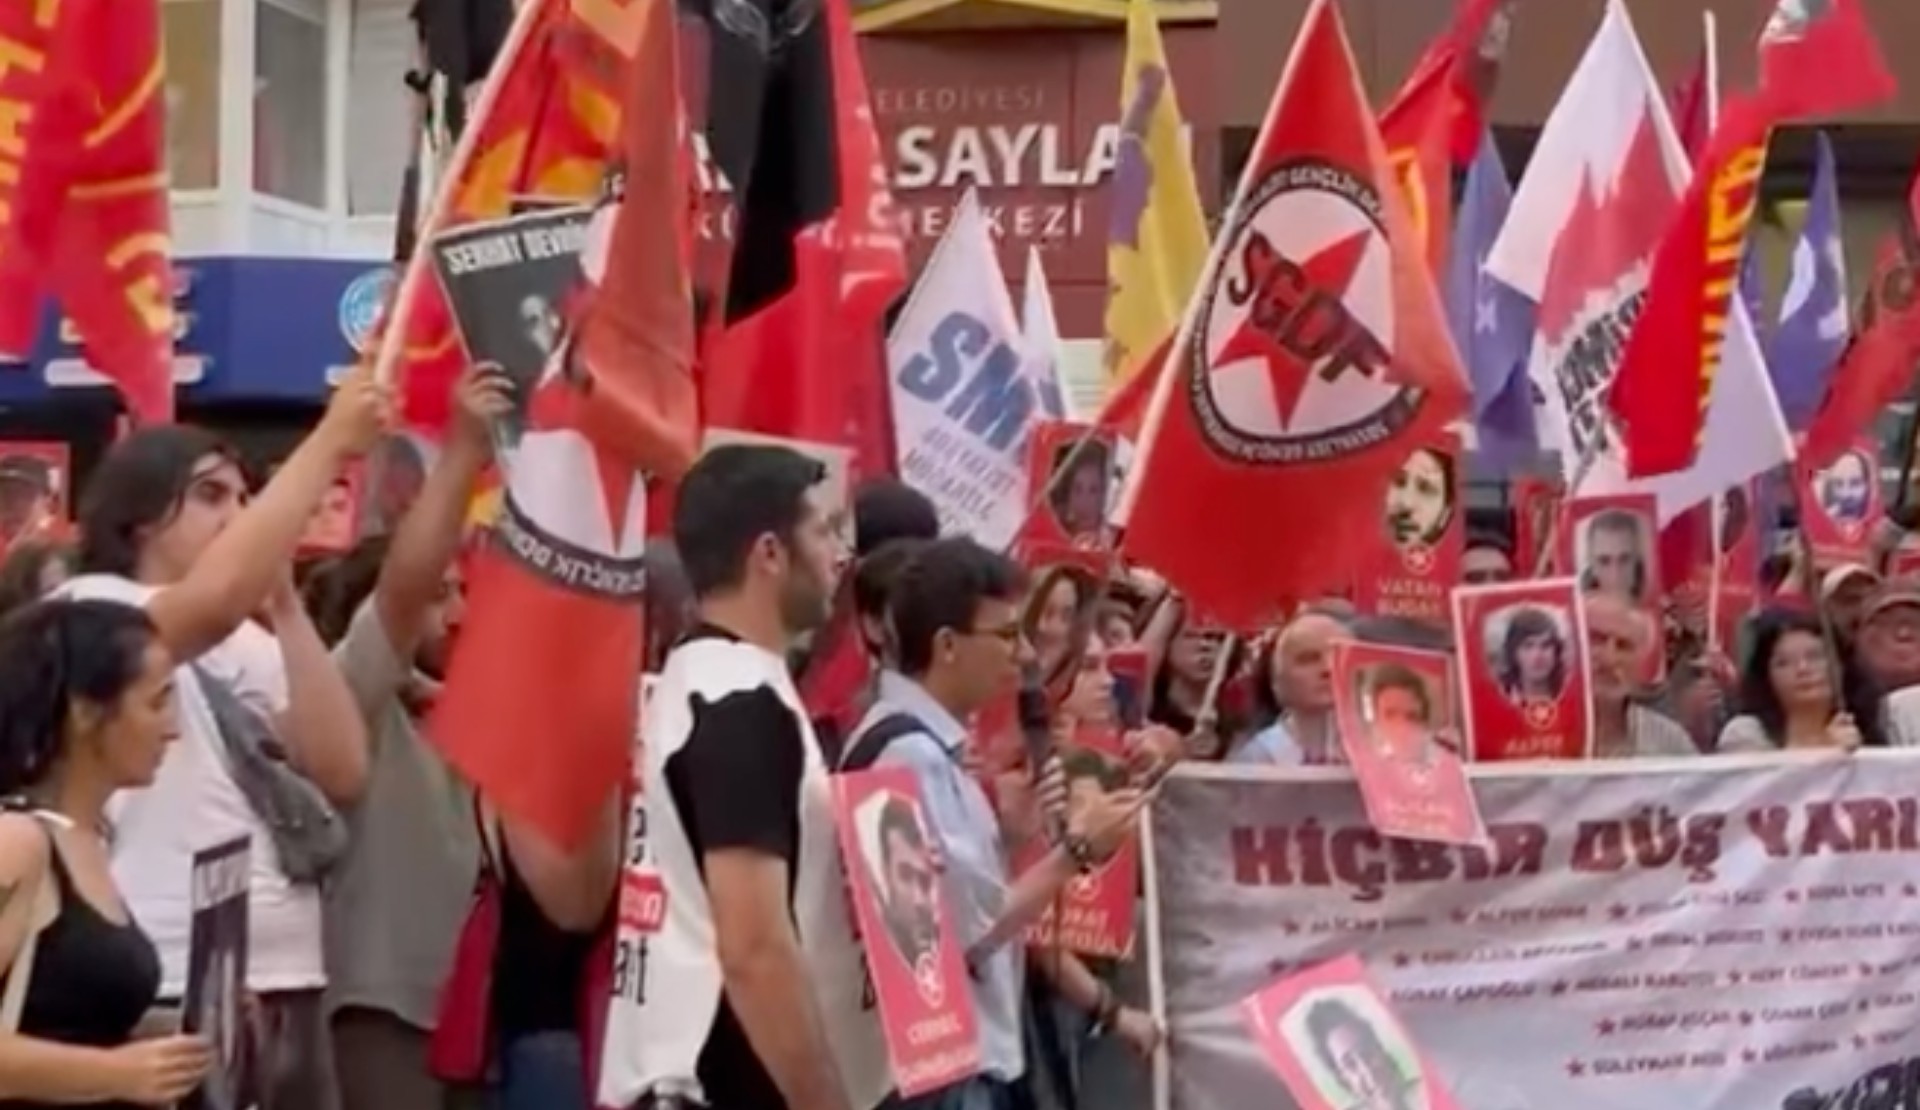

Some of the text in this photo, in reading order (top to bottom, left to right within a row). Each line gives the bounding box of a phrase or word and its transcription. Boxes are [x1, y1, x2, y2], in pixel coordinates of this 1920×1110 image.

[875, 82, 1046, 113] ELEDİYESİ
[894, 123, 1123, 189] SAYLA
[897, 310, 1035, 452] SM
[1571, 804, 1727, 884] DÜŞ
[1746, 797, 1920, 858] YARI
